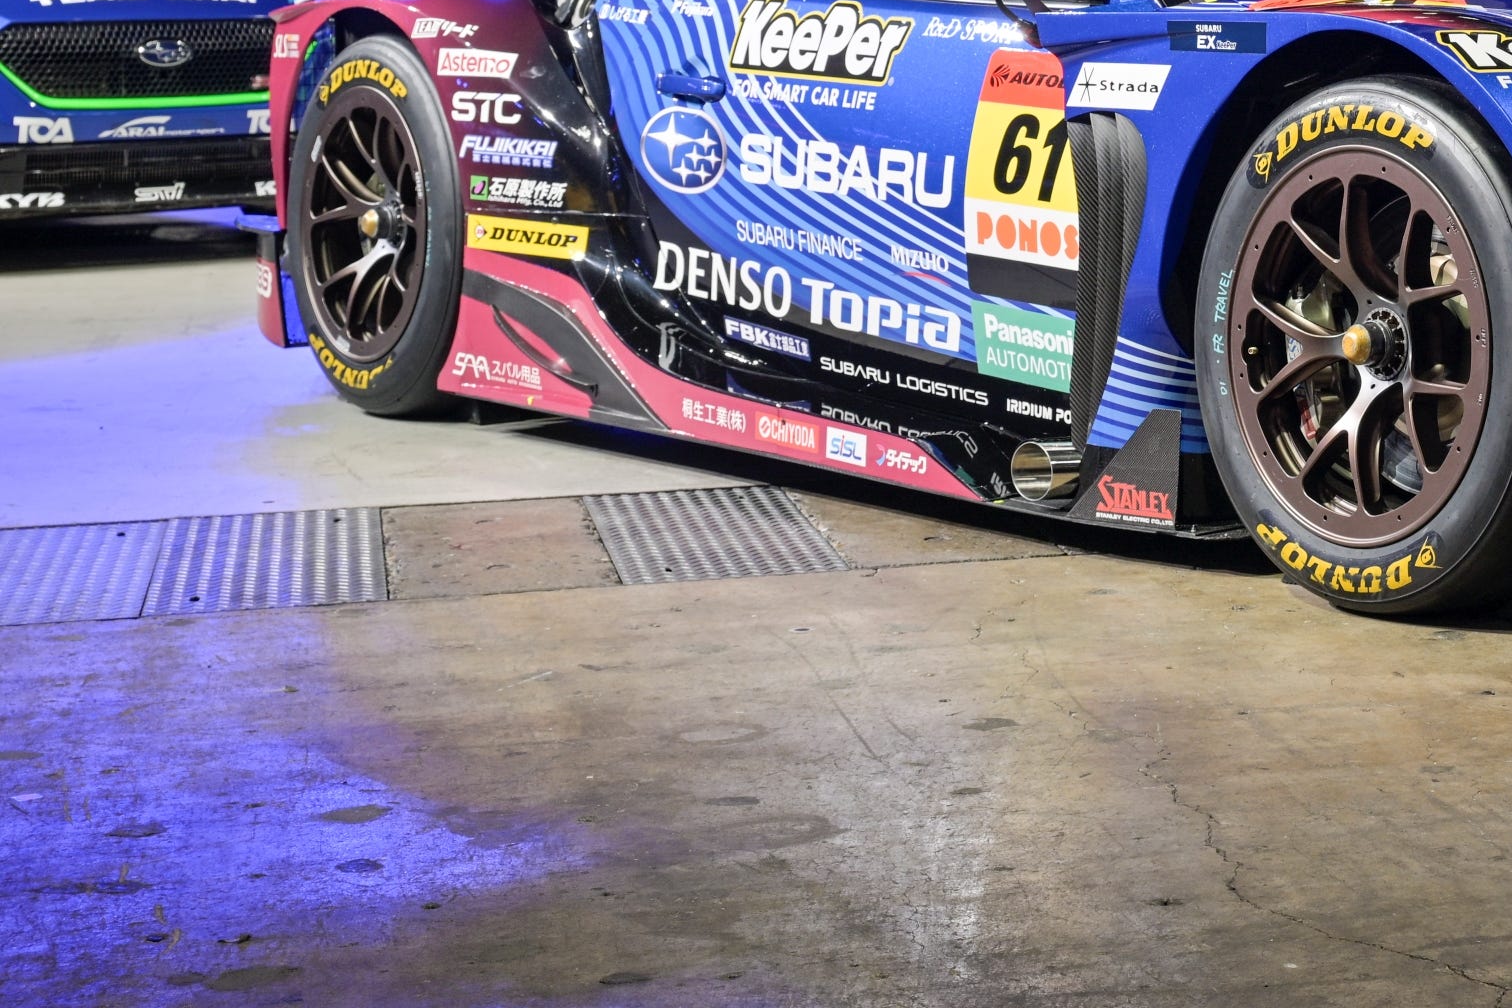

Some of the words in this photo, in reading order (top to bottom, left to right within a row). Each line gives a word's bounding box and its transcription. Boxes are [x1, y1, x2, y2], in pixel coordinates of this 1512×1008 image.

[1196, 34, 1216, 50] EX
[329, 59, 408, 99] DUNLOP
[763, 81, 811, 106] SMART
[812, 86, 839, 108] CAR
[842, 89, 877, 111] LIFE
[1099, 79, 1160, 94] Strada
[451, 90, 522, 124] STC
[13, 116, 74, 143] TOA
[459, 134, 558, 159] FUJIKIKAI
[1275, 104, 1435, 162] DUNLOP
[740, 133, 955, 209] SUBARU
[994, 113, 1069, 202] 61
[489, 177, 569, 201] 石原製作所
[490, 227, 578, 248] DUNLOP
[736, 219, 795, 252] SUBARU
[798, 230, 864, 262] FINANCE
[976, 210, 1079, 260] PONOS
[890, 244, 950, 273] MIZUHO
[652, 239, 792, 319] DENSO
[1214, 269, 1234, 323] TRAVEL
[724, 318, 770, 347] FBK
[984, 313, 1075, 356] Panasoni
[491, 360, 541, 386] スバル用品
[820, 356, 890, 385] SUBARU
[896, 374, 989, 406] LOGISTICS
[986, 346, 1073, 382] AUTOMOTI
[1006, 398, 1053, 421] IRIDIUM
[1055, 408, 1072, 424] PO
[769, 420, 815, 450] CHIYODA
[1096, 474, 1174, 520] STANLEY
[1255, 521, 1414, 594] DUNLOP
